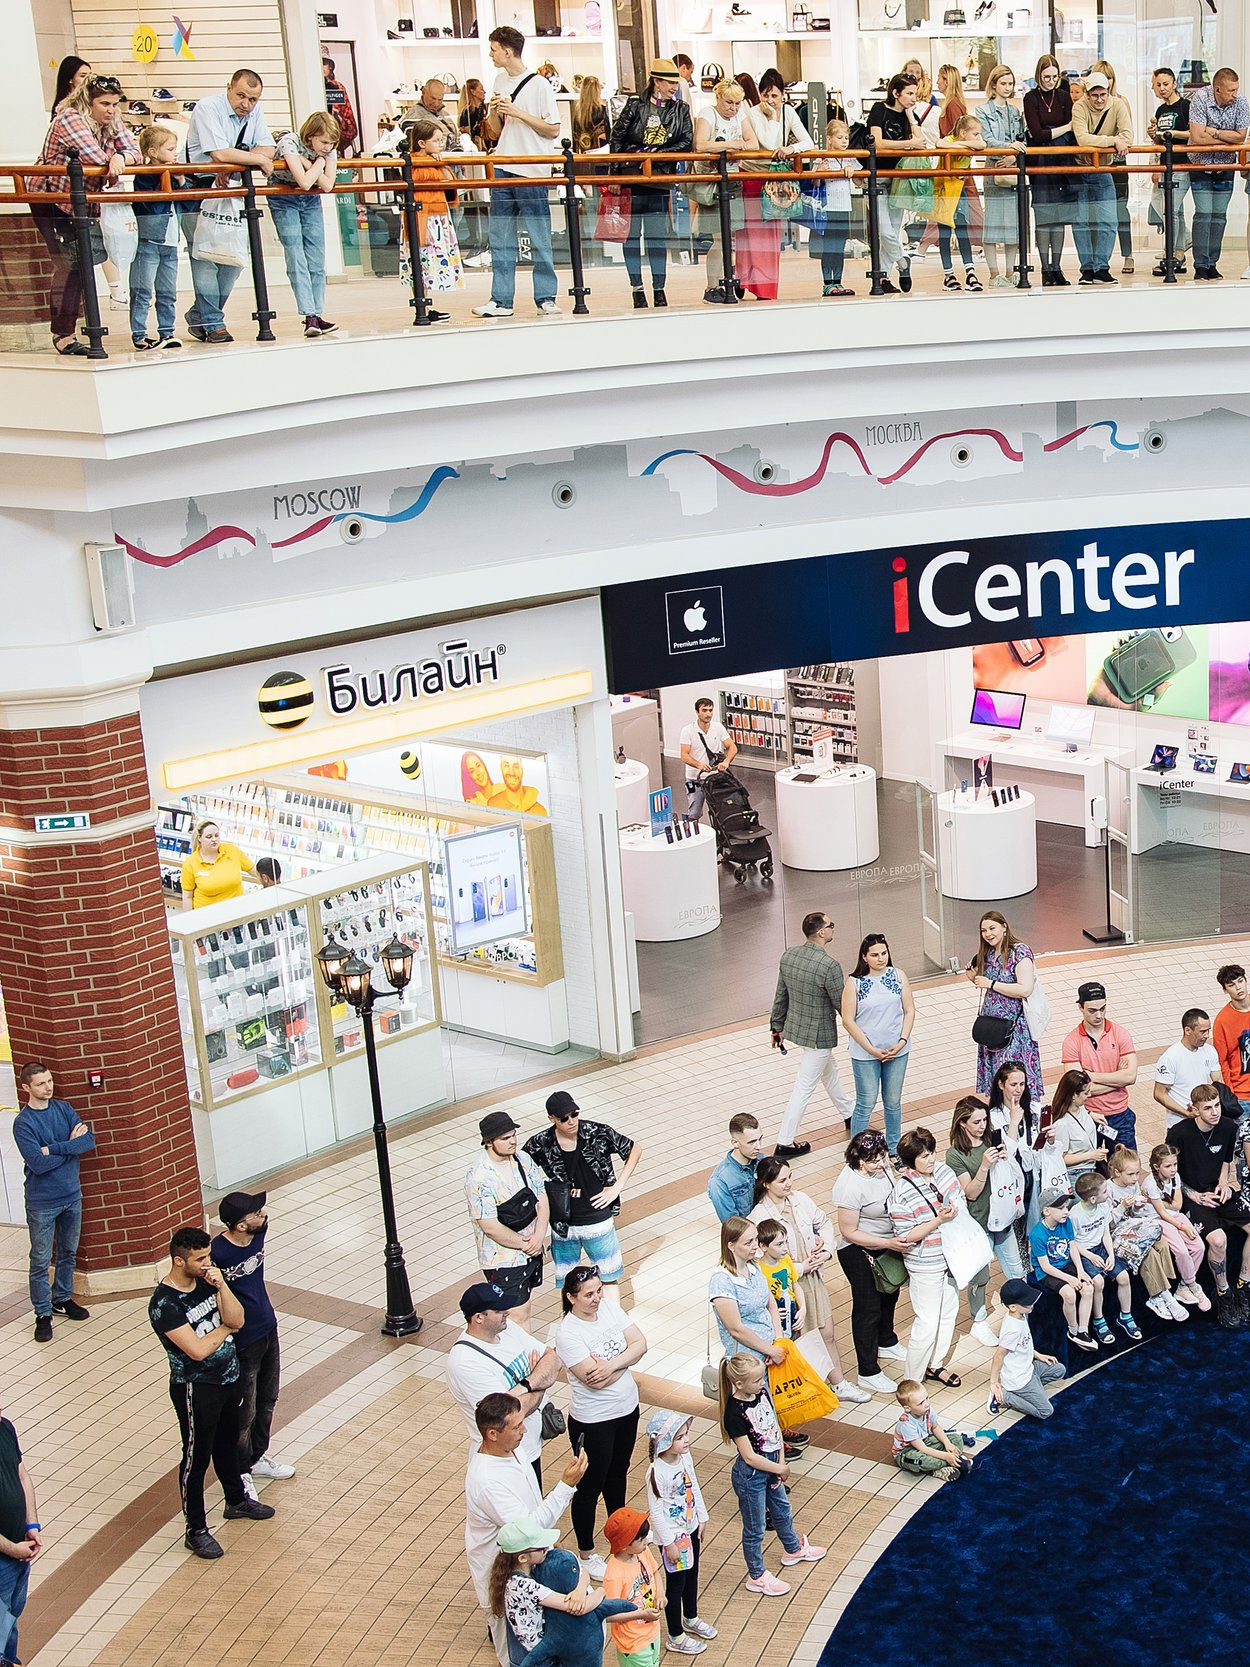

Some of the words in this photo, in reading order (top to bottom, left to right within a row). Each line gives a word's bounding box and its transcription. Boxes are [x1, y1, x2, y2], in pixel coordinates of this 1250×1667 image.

[865, 421, 924, 447] МОСКВА
[273, 485, 362, 520] MOSCOW
[892, 541, 1195, 634] iCenter
[673, 640, 699, 649] Premium
[699, 636, 721, 646] Reseller
[1160, 780, 1195, 790] iCenter
[850, 867, 888, 880] ЕВРОПА
[678, 905, 717, 921] ЕВРОПА
